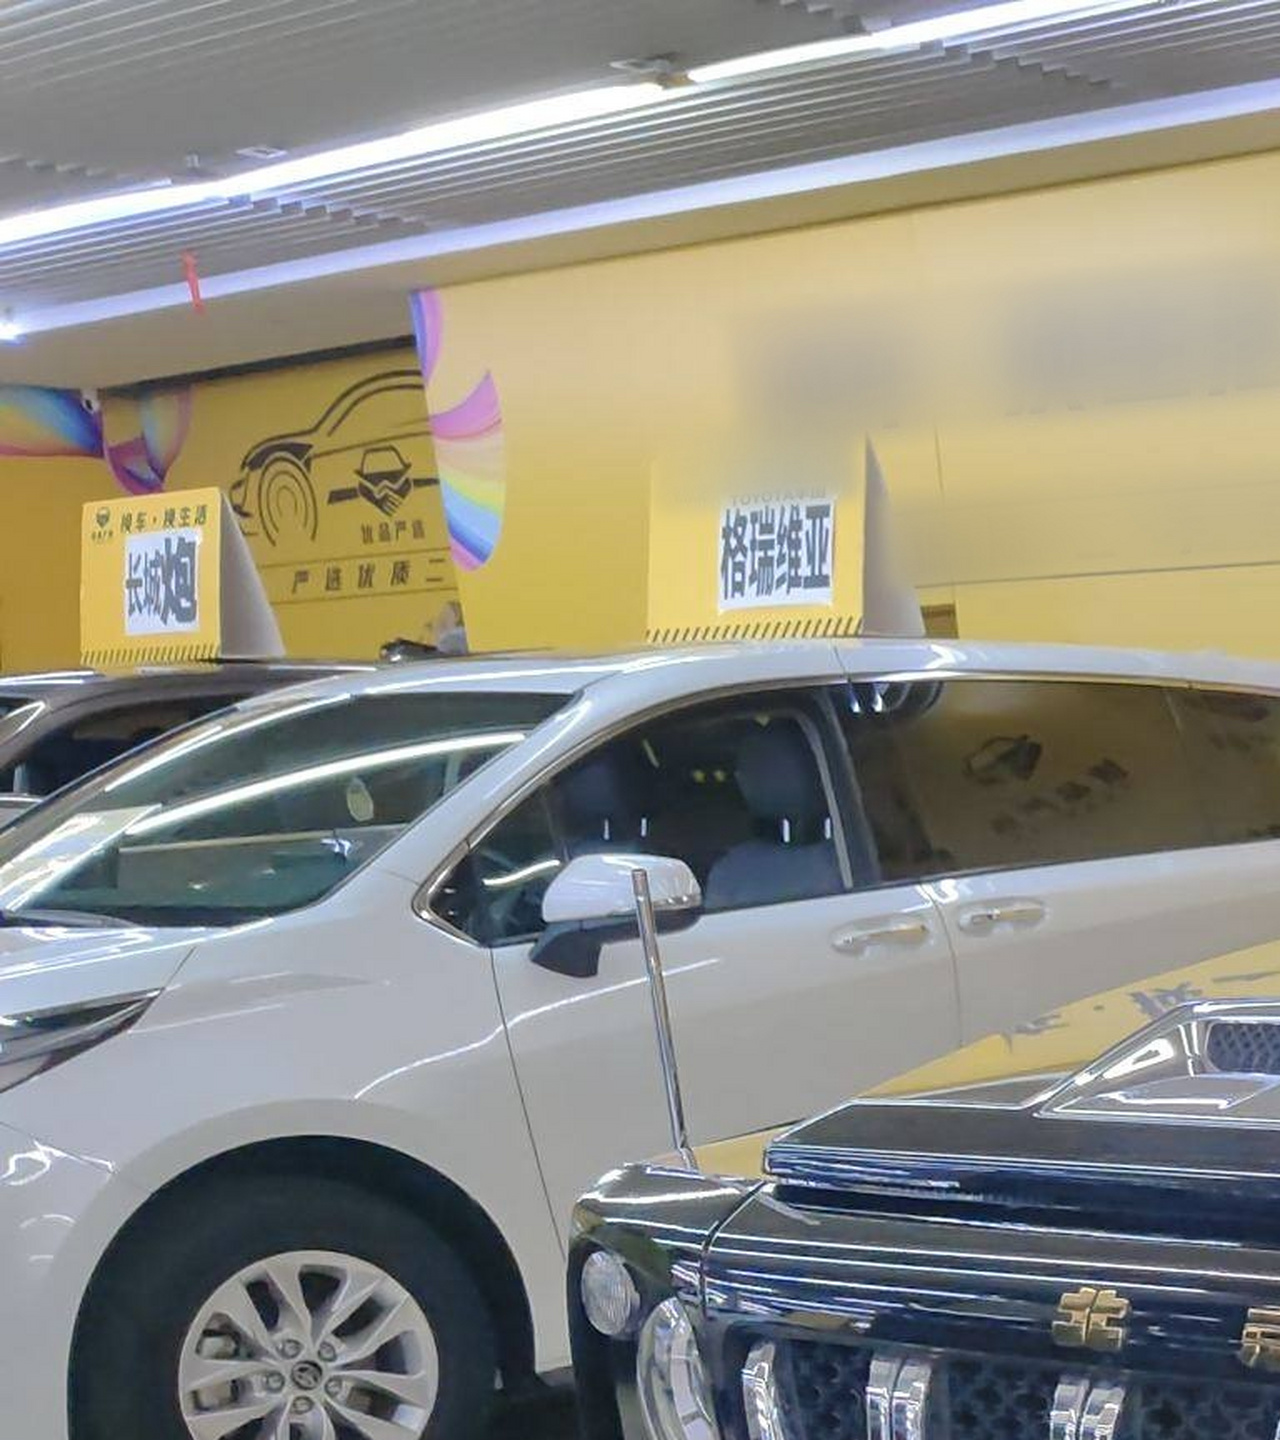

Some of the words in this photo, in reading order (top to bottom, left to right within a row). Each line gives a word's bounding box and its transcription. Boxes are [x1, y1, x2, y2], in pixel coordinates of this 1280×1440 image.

[126, 537, 197, 625] 长城炮
[721, 504, 831, 600] 格瑞维亚
